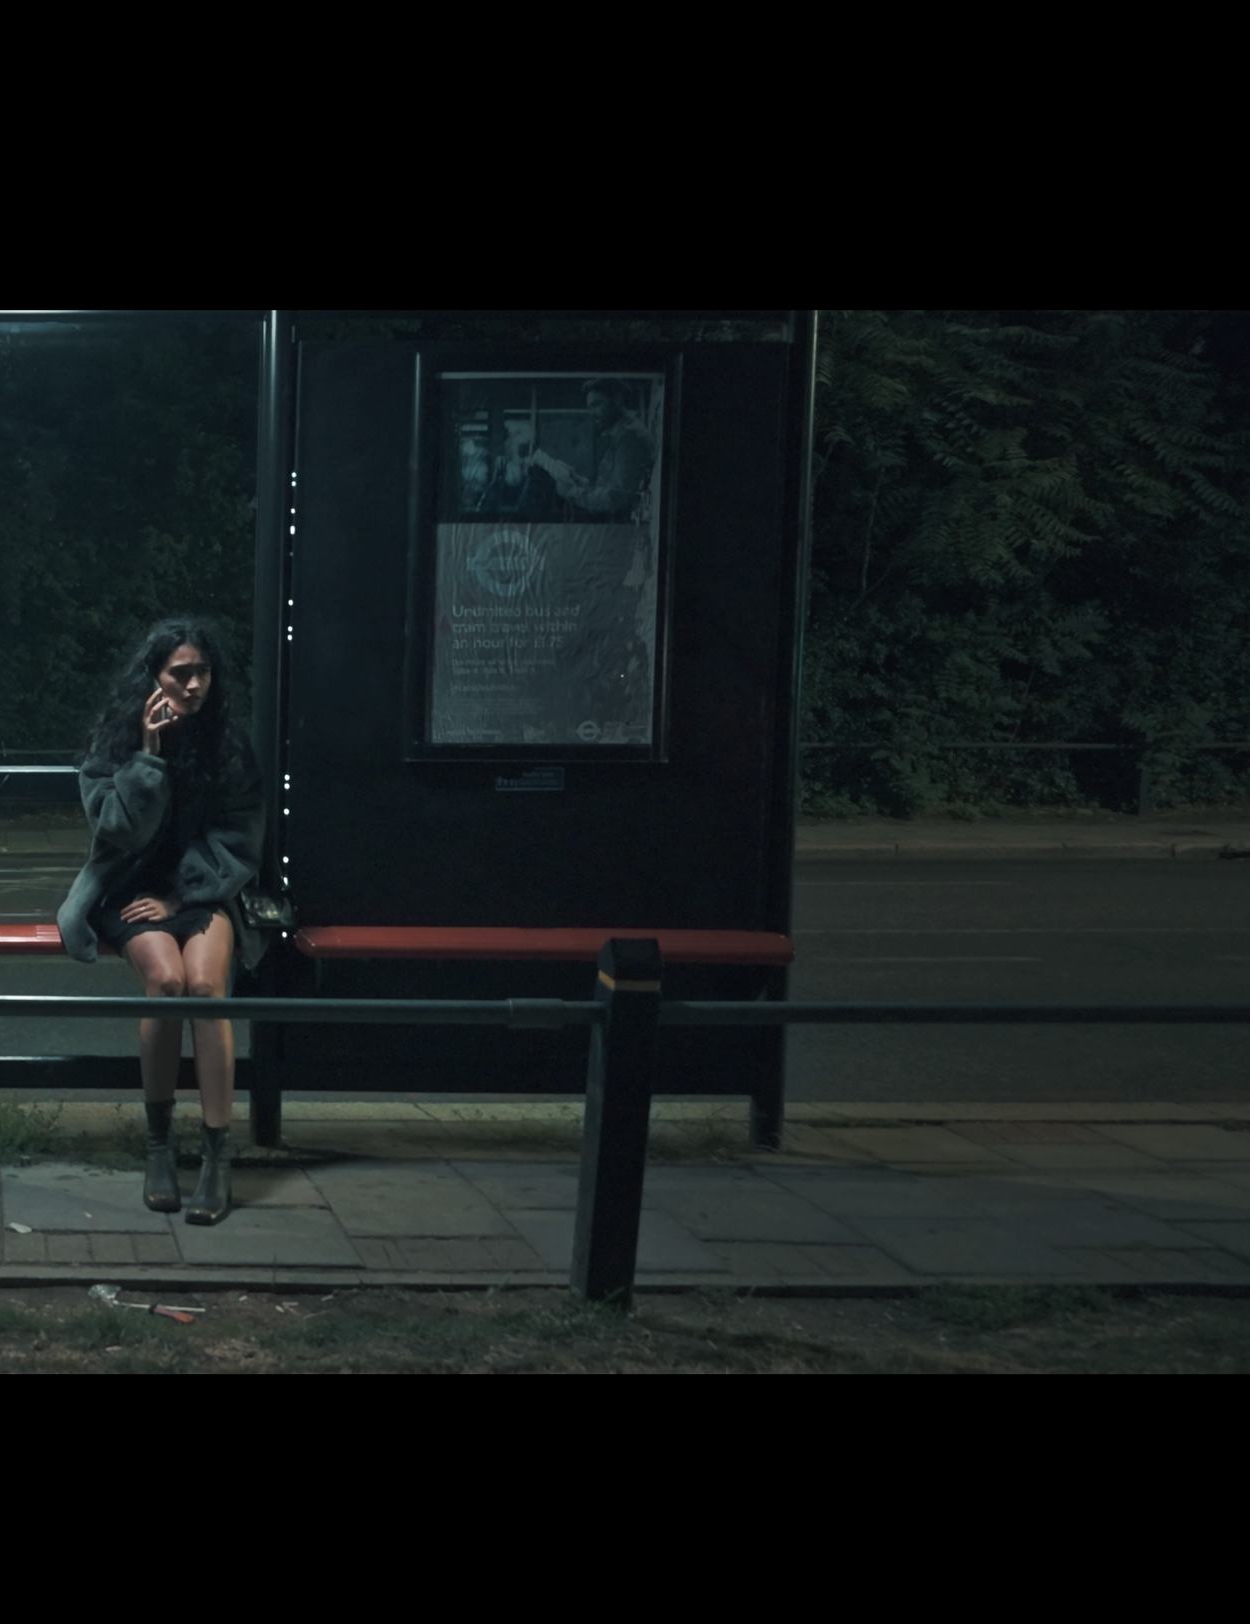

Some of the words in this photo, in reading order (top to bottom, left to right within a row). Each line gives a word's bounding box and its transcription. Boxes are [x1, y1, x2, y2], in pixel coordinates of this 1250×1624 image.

[452, 605, 521, 618] Unlimited
[526, 605, 550, 617] bus
[553, 604, 580, 617] and
[453, 622, 487, 634] tram
[490, 621, 528, 634] travel
[534, 621, 578, 632] within
[452, 639, 469, 650] an
[473, 637, 505, 649] hour
[509, 636, 528, 649] for
[534, 636, 564, 649] £1.75
